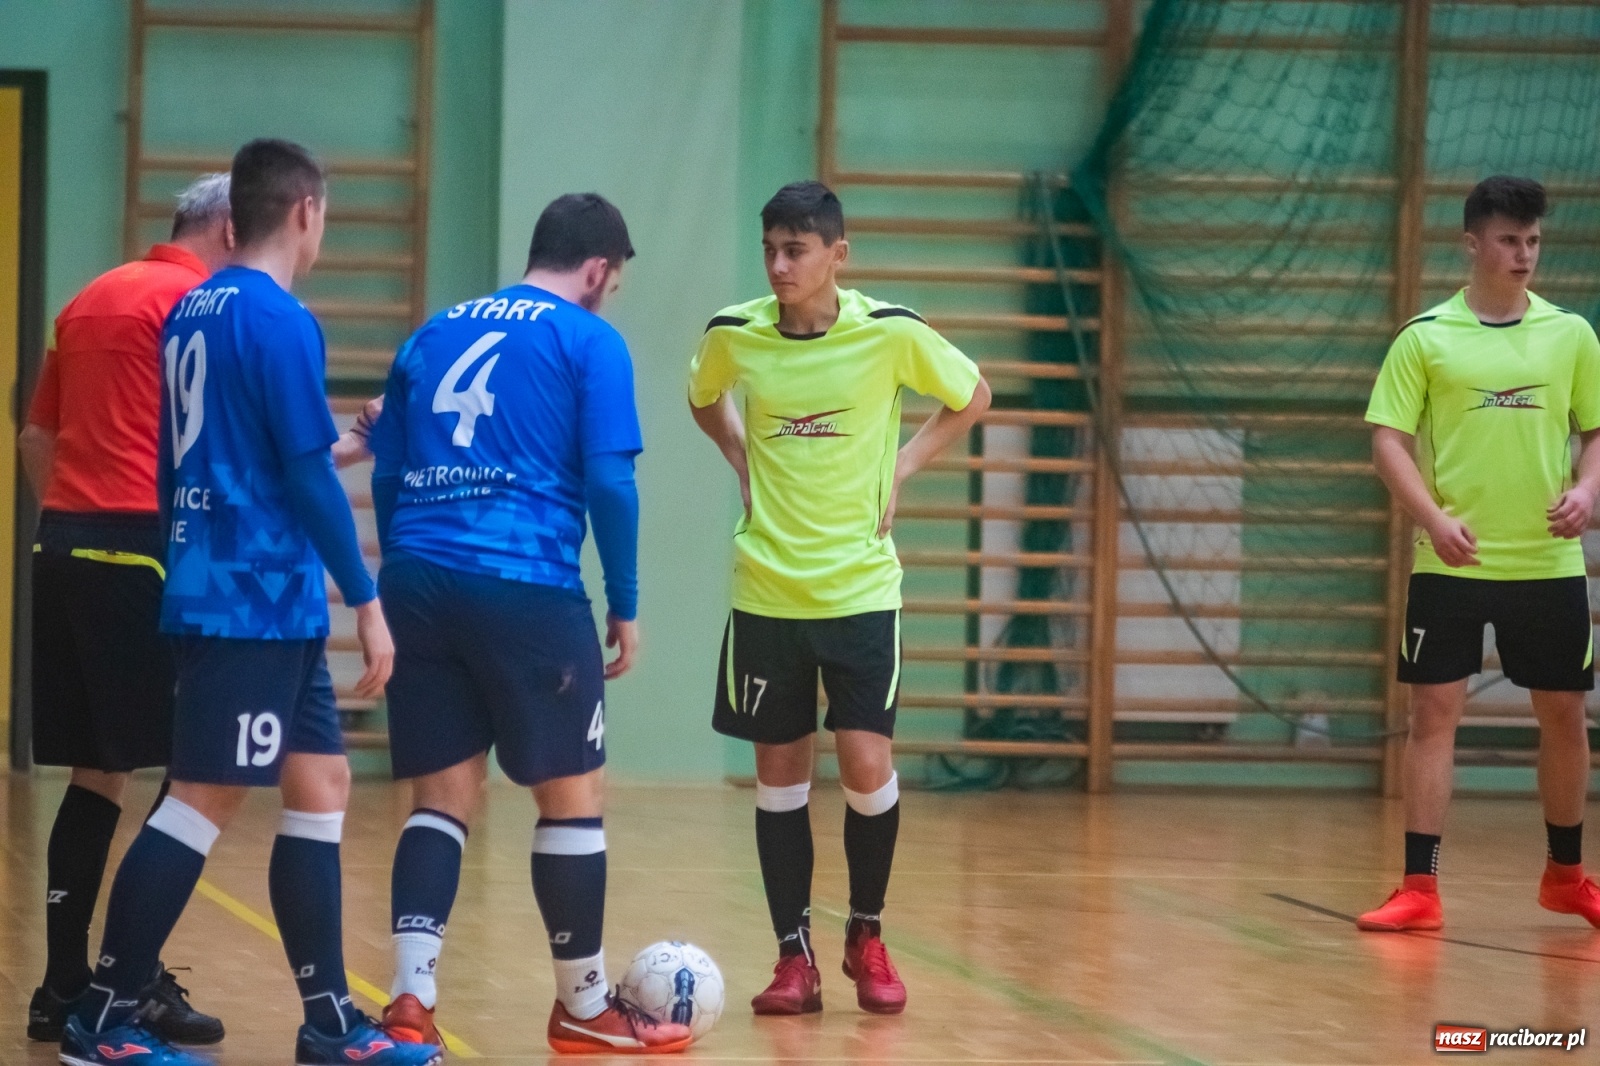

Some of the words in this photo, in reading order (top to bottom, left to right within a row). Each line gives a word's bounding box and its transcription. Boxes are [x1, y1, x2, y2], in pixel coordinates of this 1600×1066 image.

[174, 286, 240, 321] START
[447, 297, 557, 321] START
[164, 330, 207, 470] 19
[432, 331, 508, 448] 4
[1412, 627, 1426, 664] 7
[743, 674, 768, 717] 17
[236, 712, 281, 767] 19
[586, 700, 604, 751] 4
